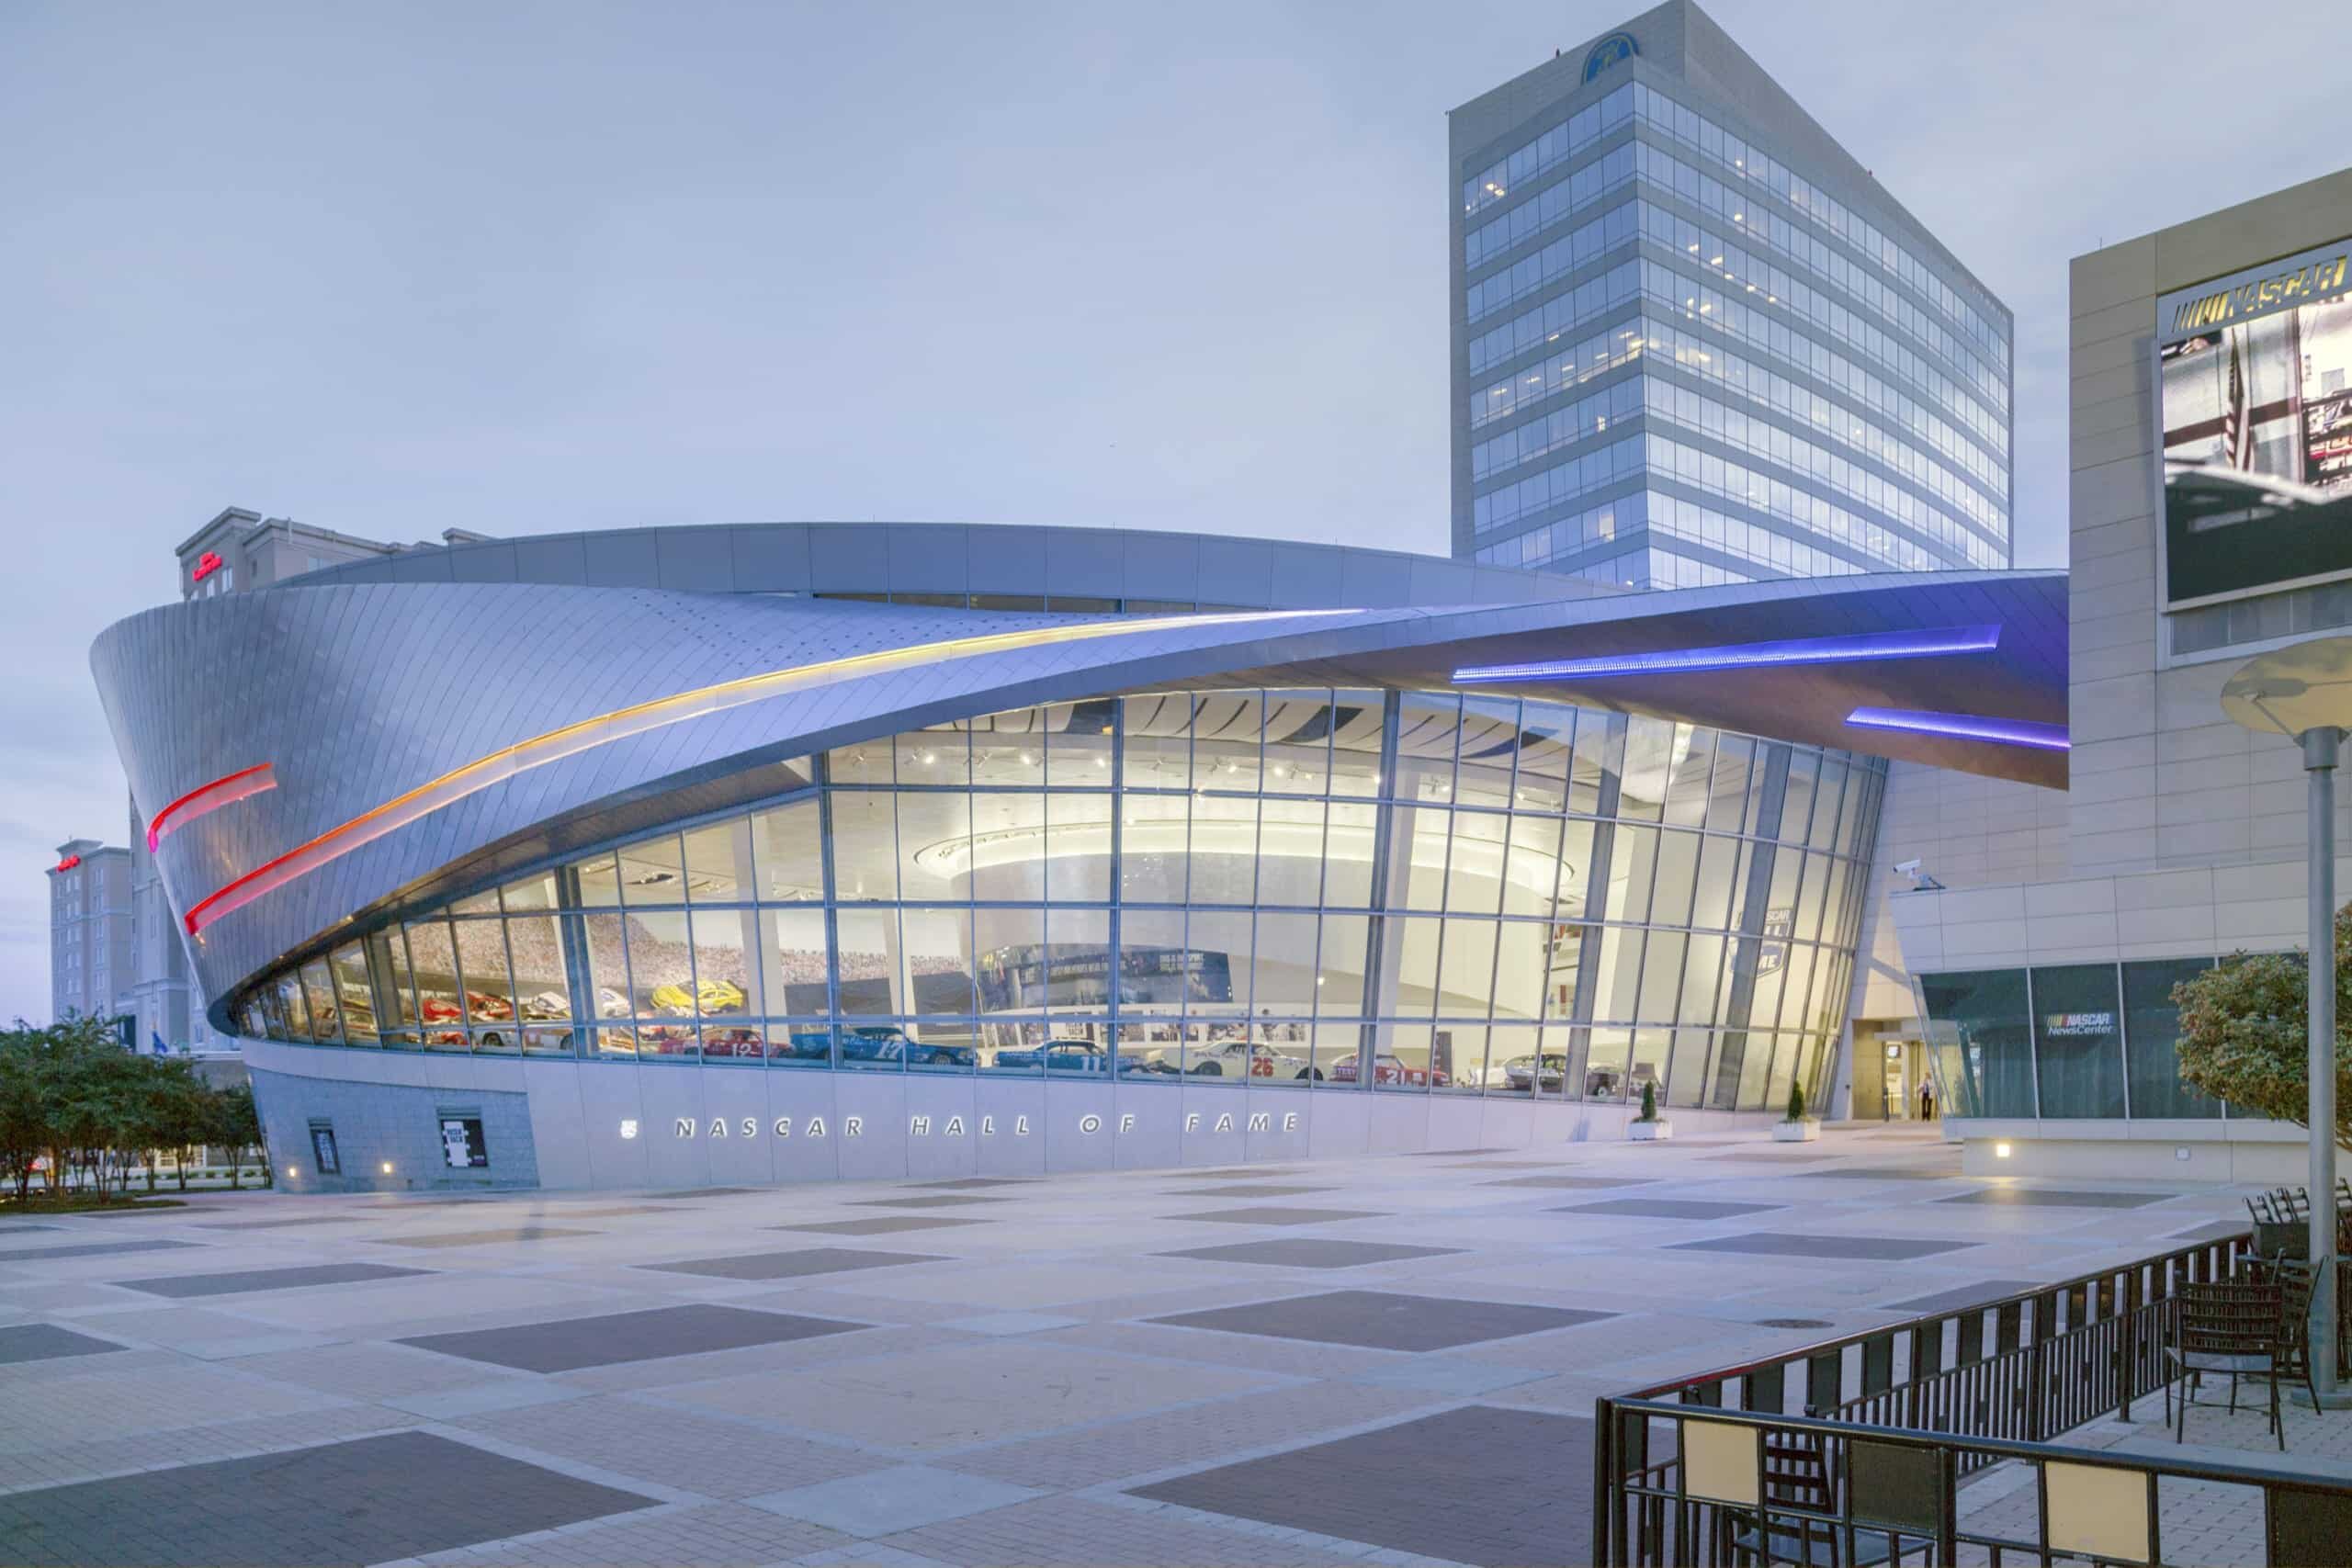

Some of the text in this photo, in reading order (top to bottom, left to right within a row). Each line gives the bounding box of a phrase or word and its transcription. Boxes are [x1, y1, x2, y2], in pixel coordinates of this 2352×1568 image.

[2222, 258, 2340, 319] NASCAR
[2066, 1013, 2110, 1025] NASCAR
[2048, 1025, 2112, 1036] NewsCenter
[875, 1040, 903, 1059] 17
[1080, 1056, 1101, 1073] 11
[675, 1112, 1297, 1138] NASCAR HALL OF FAME
